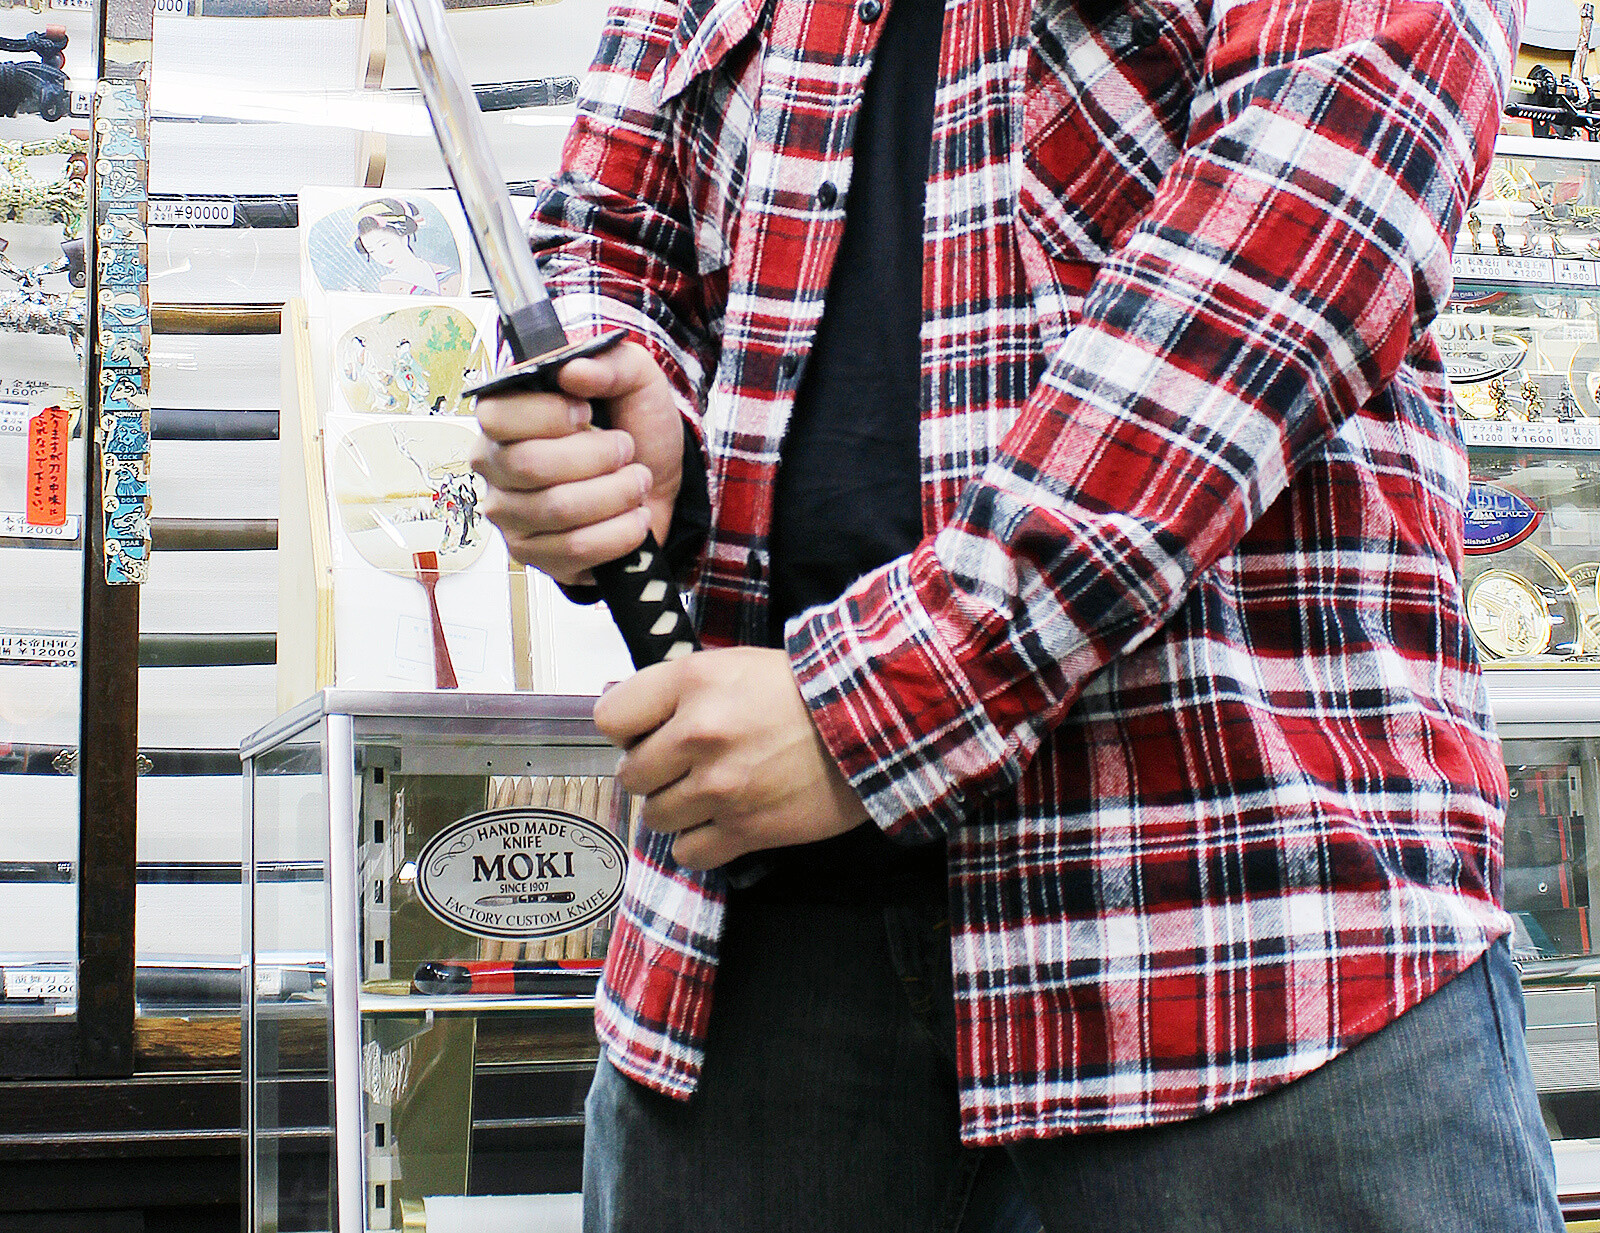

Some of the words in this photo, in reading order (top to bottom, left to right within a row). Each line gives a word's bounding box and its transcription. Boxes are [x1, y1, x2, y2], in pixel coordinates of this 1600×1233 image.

[175, 205, 229, 219] ¥90000
[1512, 434, 1554, 444] ¥1600
[6, 524, 63, 535] ¥12000
[477, 822, 520, 841] HAND
[524, 822, 567, 838] MADE
[502, 835, 542, 849] KNIFE
[472, 851, 576, 882] MOKI
[499, 883, 527, 894] SINCE
[529, 881, 550, 892] 1907
[445, 896, 503, 926] FACTORY
[505, 911, 561, 926] CUSTOM
[567, 888, 608, 918] KNIFE
